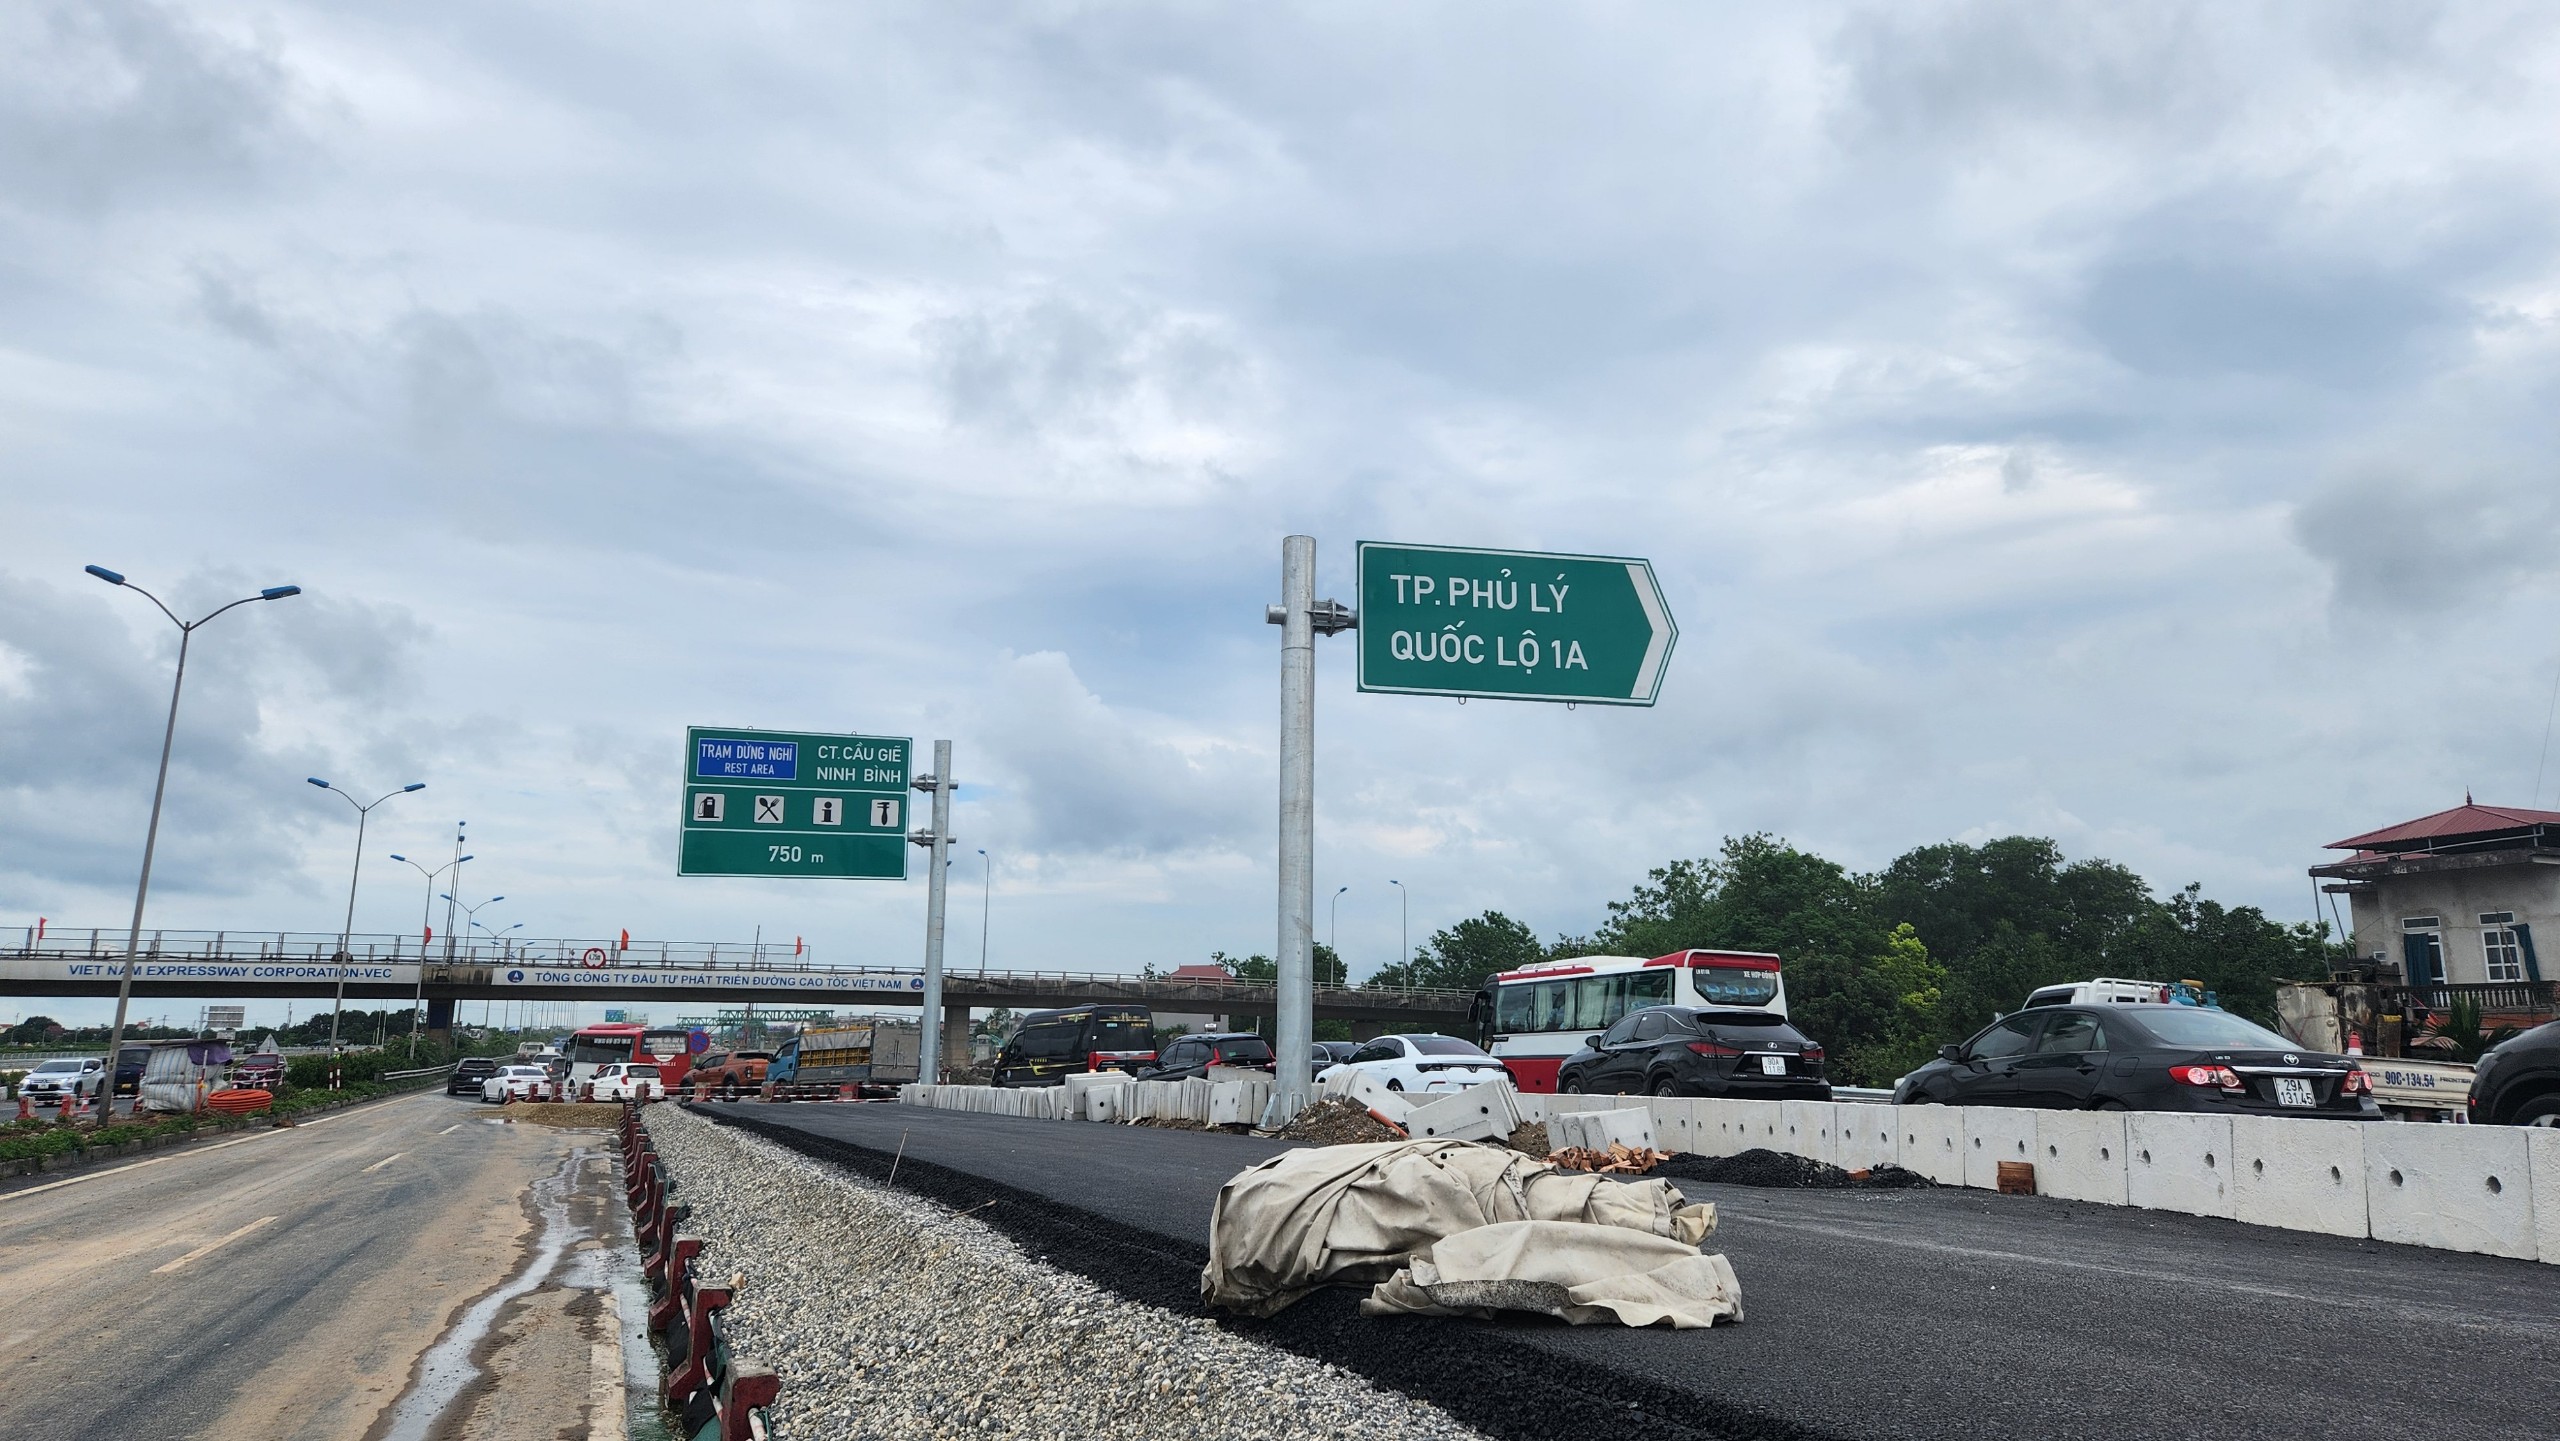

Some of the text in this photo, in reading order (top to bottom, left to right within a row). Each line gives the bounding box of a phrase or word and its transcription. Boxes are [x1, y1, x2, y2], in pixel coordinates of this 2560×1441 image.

[1531, 573, 1569, 614] LÝ
[1391, 620, 1589, 674] QUỐC LỘ 1A
[702, 742, 793, 761] TRẠM DỪNG NGHỈ
[724, 763, 774, 774] REST AREA
[817, 765, 901, 783] NINH BÌNH
[769, 846, 824, 863] 750 m
[69, 965, 103, 975] VIET
[146, 966, 249, 977] EXPRESSWAY
[574, 971, 610, 982] CÔNG
[614, 974, 628, 983] TY
[661, 975, 678, 984] TƯ
[681, 973, 712, 984] PHÁT
[753, 975, 795, 986] ĐƯỜNG
[799, 978, 823, 986] CAO
[852, 978, 875, 989] VIỆT
[878, 980, 902, 989] NAM
[2284, 1080, 2303, 1092] 29A
[2385, 1071, 2435, 1088] 90C-134.54
[2280, 1092, 2313, 1105] 131.45
